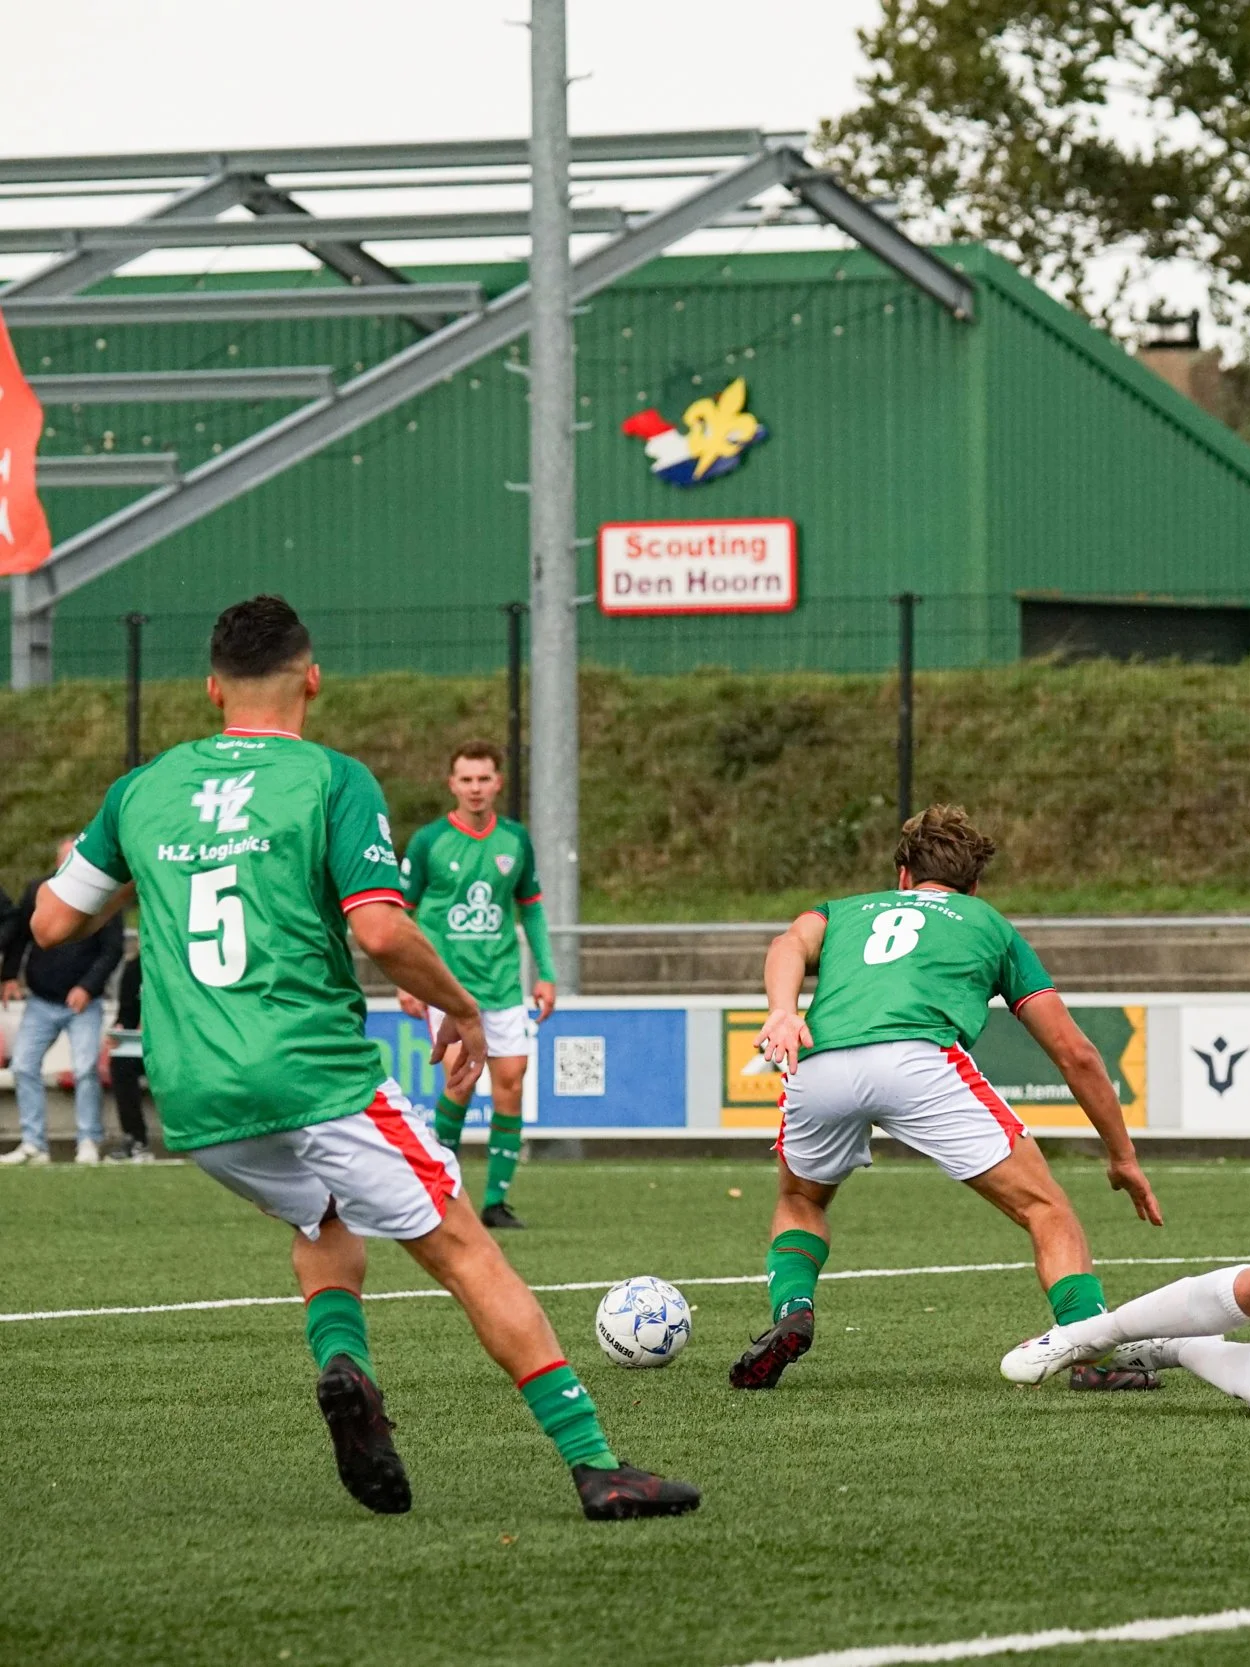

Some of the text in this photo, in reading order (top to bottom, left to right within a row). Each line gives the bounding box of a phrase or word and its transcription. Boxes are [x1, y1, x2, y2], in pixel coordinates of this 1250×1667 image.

[626, 531, 767, 562] Scouting
[614, 570, 781, 595] Den Hoorn
[158, 836, 270, 861] H.Z. Logistics
[188, 864, 247, 987] 5
[863, 907, 926, 965] 8
